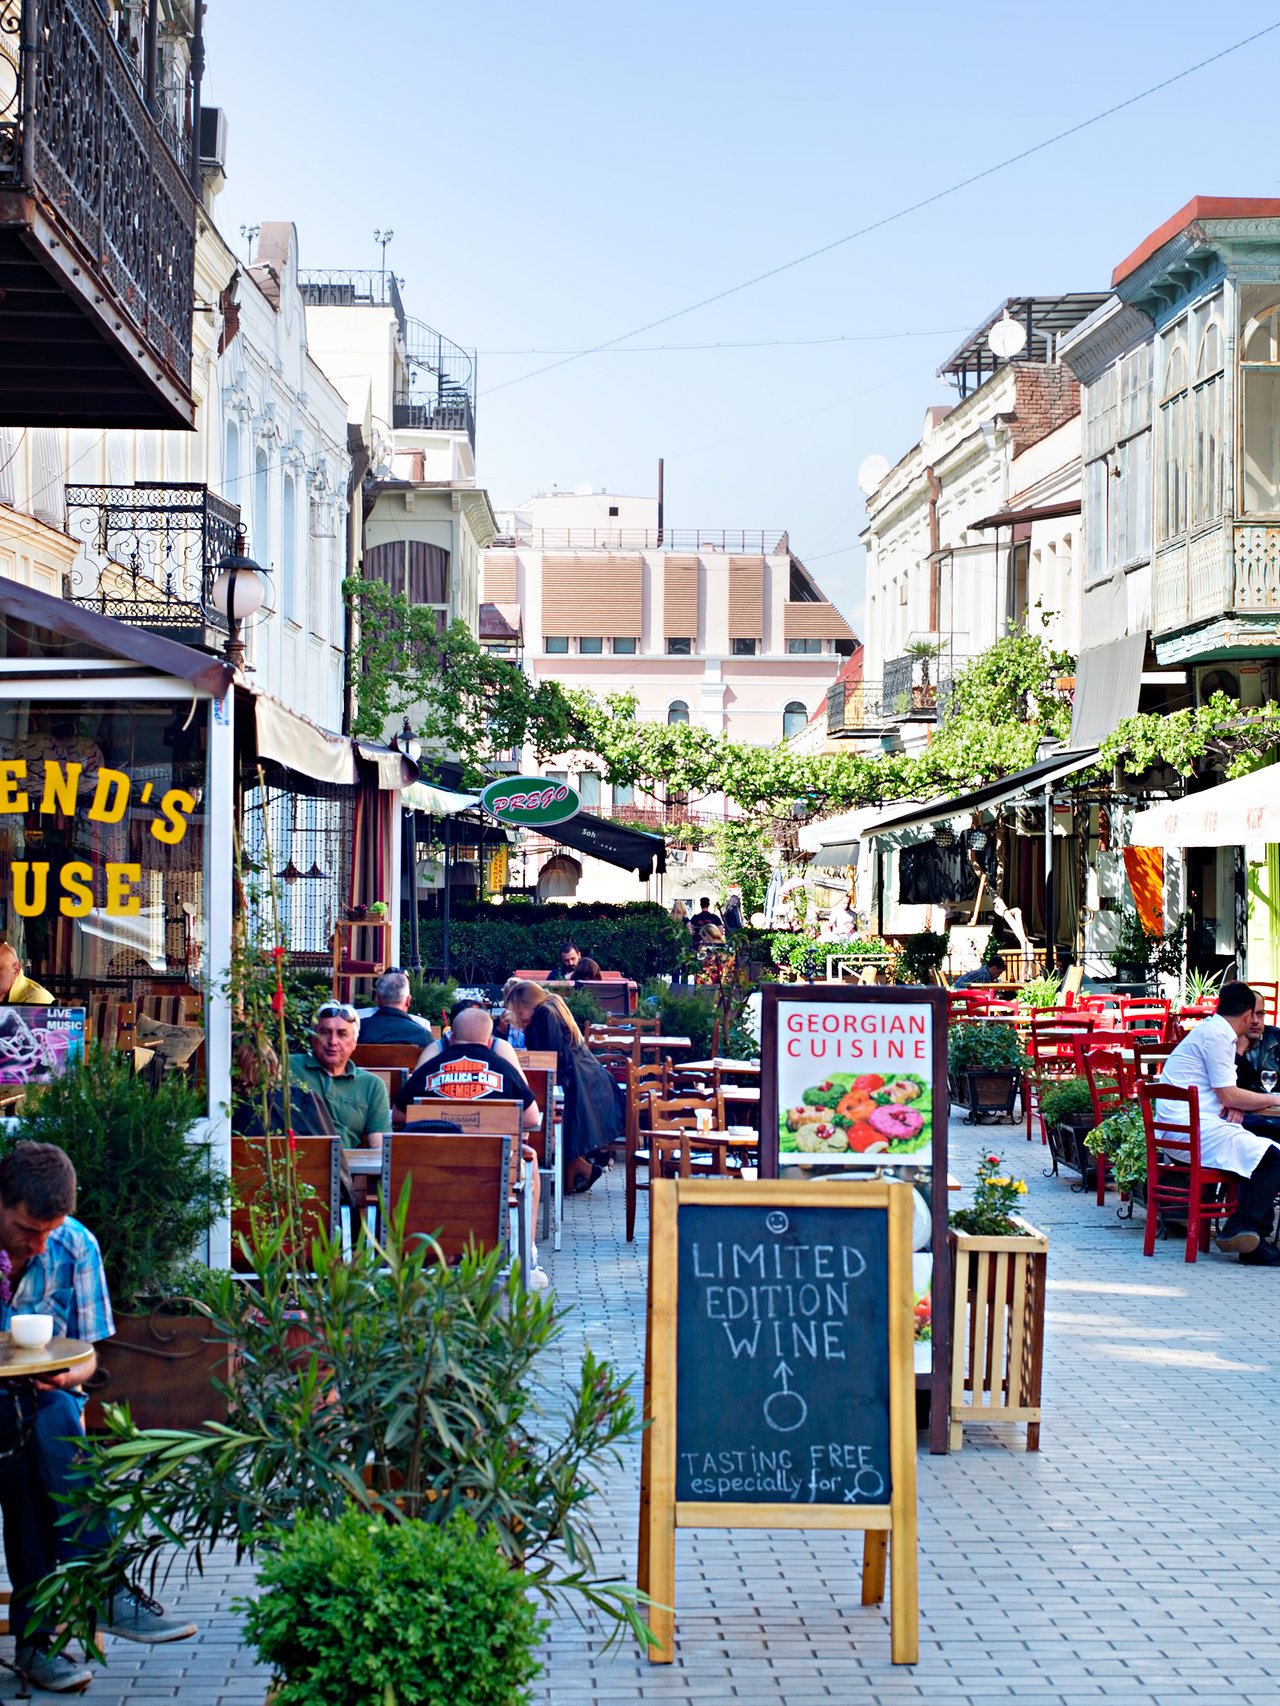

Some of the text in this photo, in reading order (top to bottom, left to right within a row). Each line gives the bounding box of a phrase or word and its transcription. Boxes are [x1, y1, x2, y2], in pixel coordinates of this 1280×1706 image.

[0, 760, 195, 844] END'S
[493, 786, 569, 815] PREGO
[11, 862, 141, 917] USE
[47, 1009, 72, 1018] LIVE
[47, 1021, 82, 1030] MUSIC
[787, 1014, 925, 1034] GEORGIAN
[787, 1038, 926, 1059] CUISINE
[692, 1242, 867, 1279] LIMITED
[706, 1282, 849, 1320] EDITION
[722, 1320, 845, 1359] WINE
[810, 1443, 873, 1469] FREE
[691, 1468, 841, 1503] especially for
